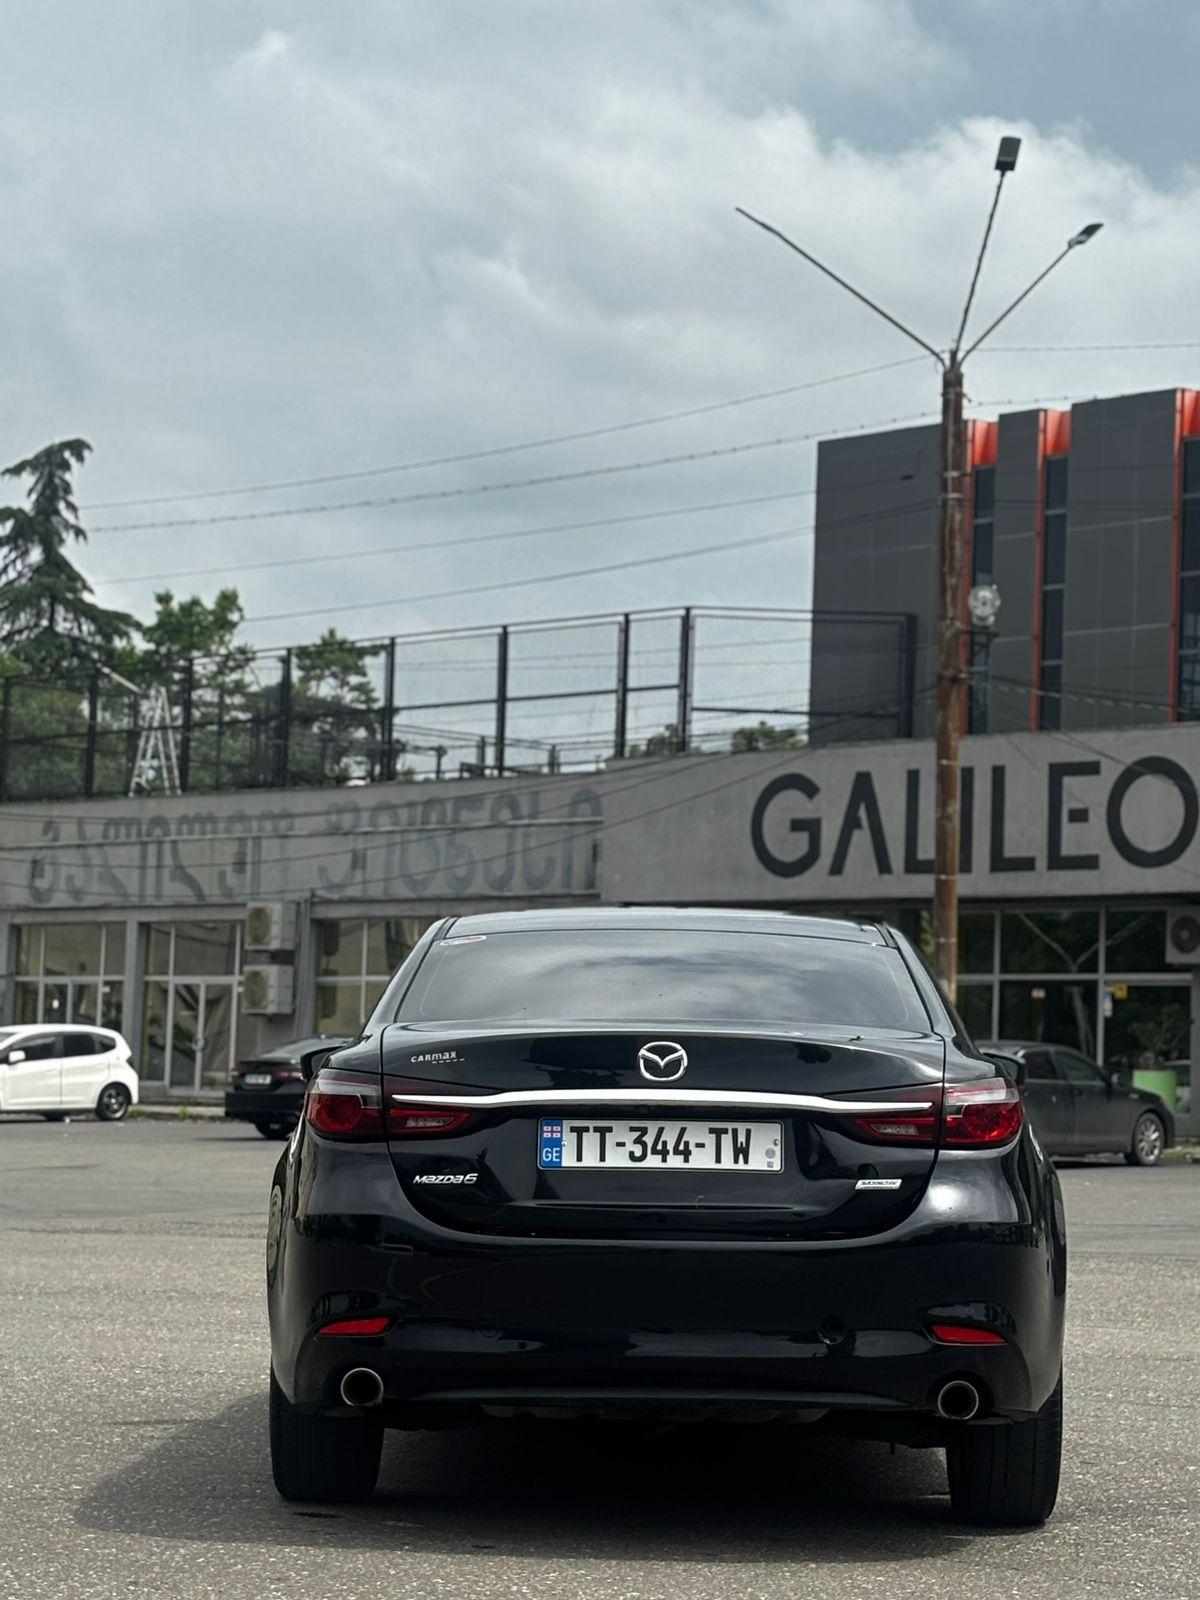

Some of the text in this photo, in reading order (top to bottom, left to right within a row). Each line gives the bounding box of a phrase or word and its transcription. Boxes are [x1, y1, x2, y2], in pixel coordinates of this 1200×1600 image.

[750, 755, 1199, 878] GALILEO
[542, 1147, 561, 1162] GE
[569, 1125, 752, 1165] TT-344-TW
